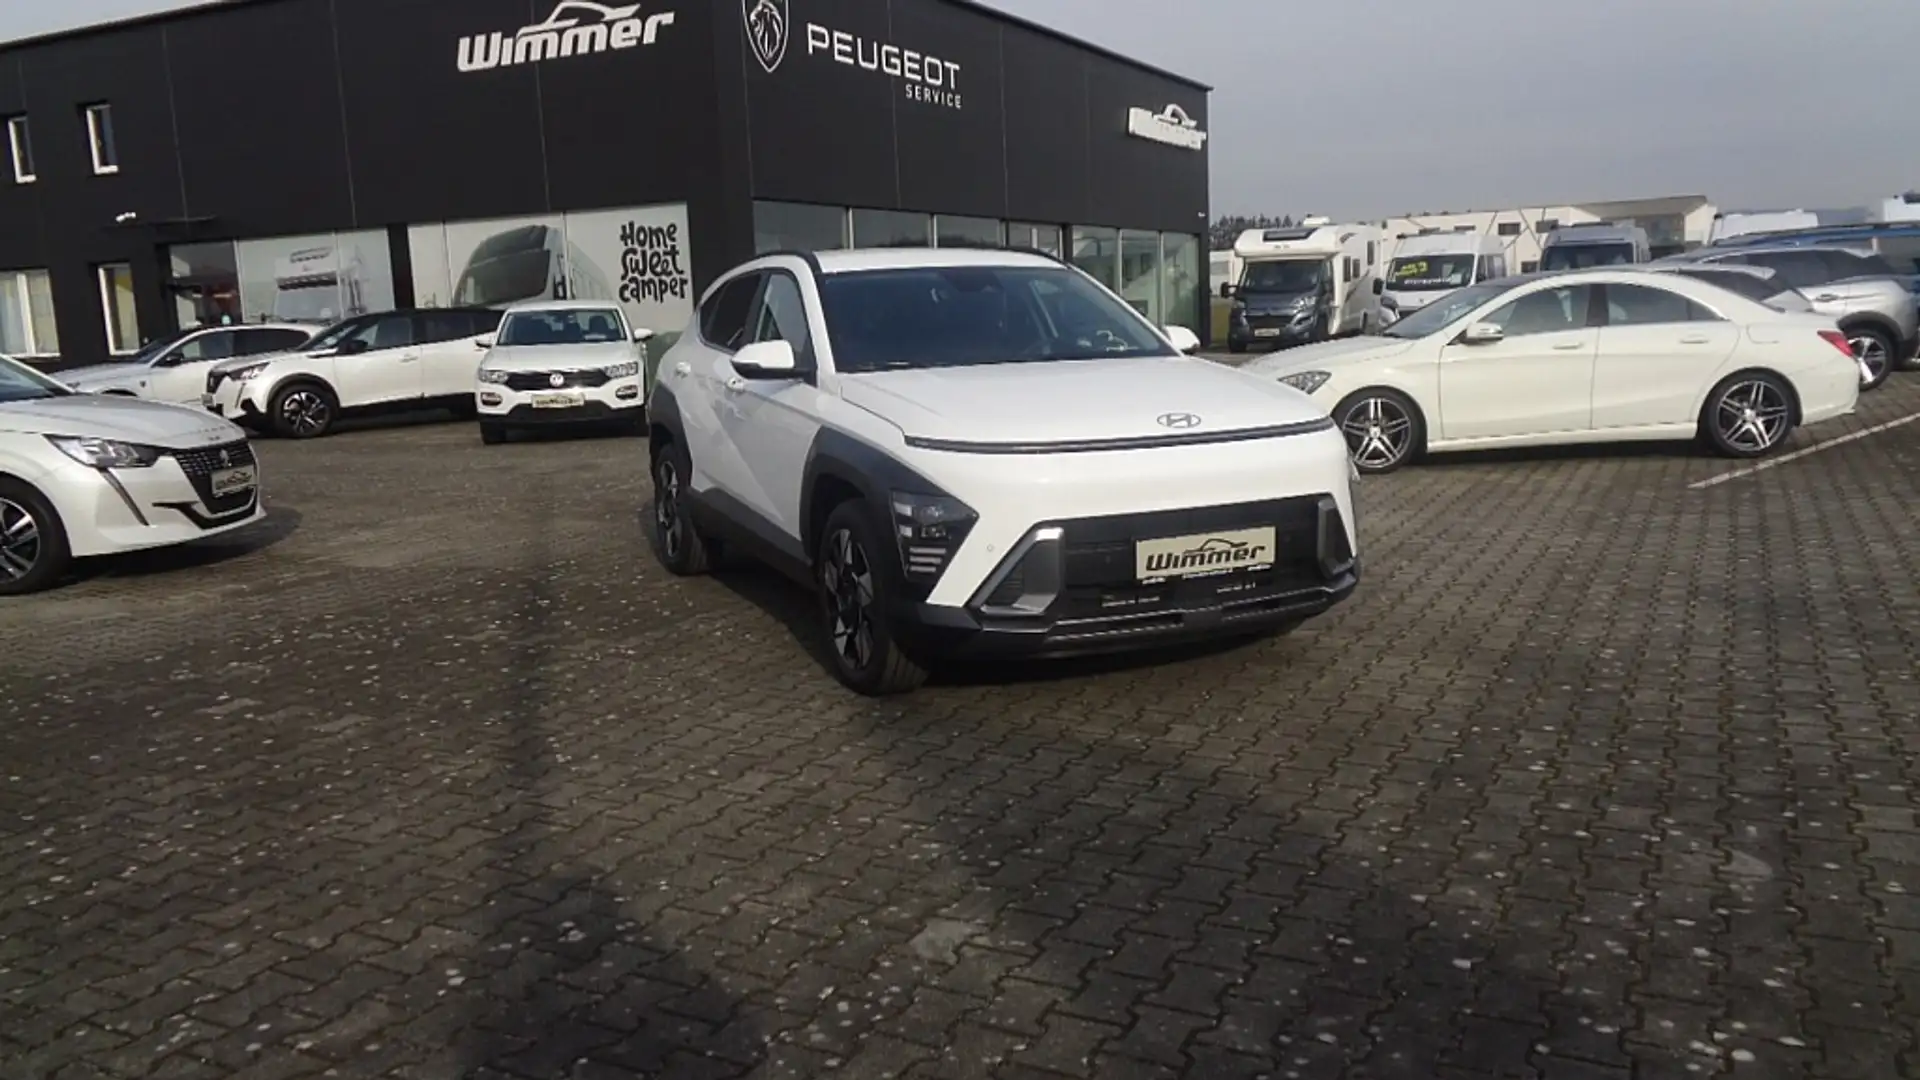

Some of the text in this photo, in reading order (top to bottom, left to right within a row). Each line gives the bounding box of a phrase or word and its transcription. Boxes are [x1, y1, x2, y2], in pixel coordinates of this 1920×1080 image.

[456, 10, 675, 73] Wimmer
[806, 22, 960, 91] PEUGEOT
[905, 83, 963, 110] SERVICE
[619, 219, 678, 250] Home
[620, 244, 685, 281] Sweet
[618, 276, 688, 304] camper
[1145, 545, 1266, 572] Wimmer
